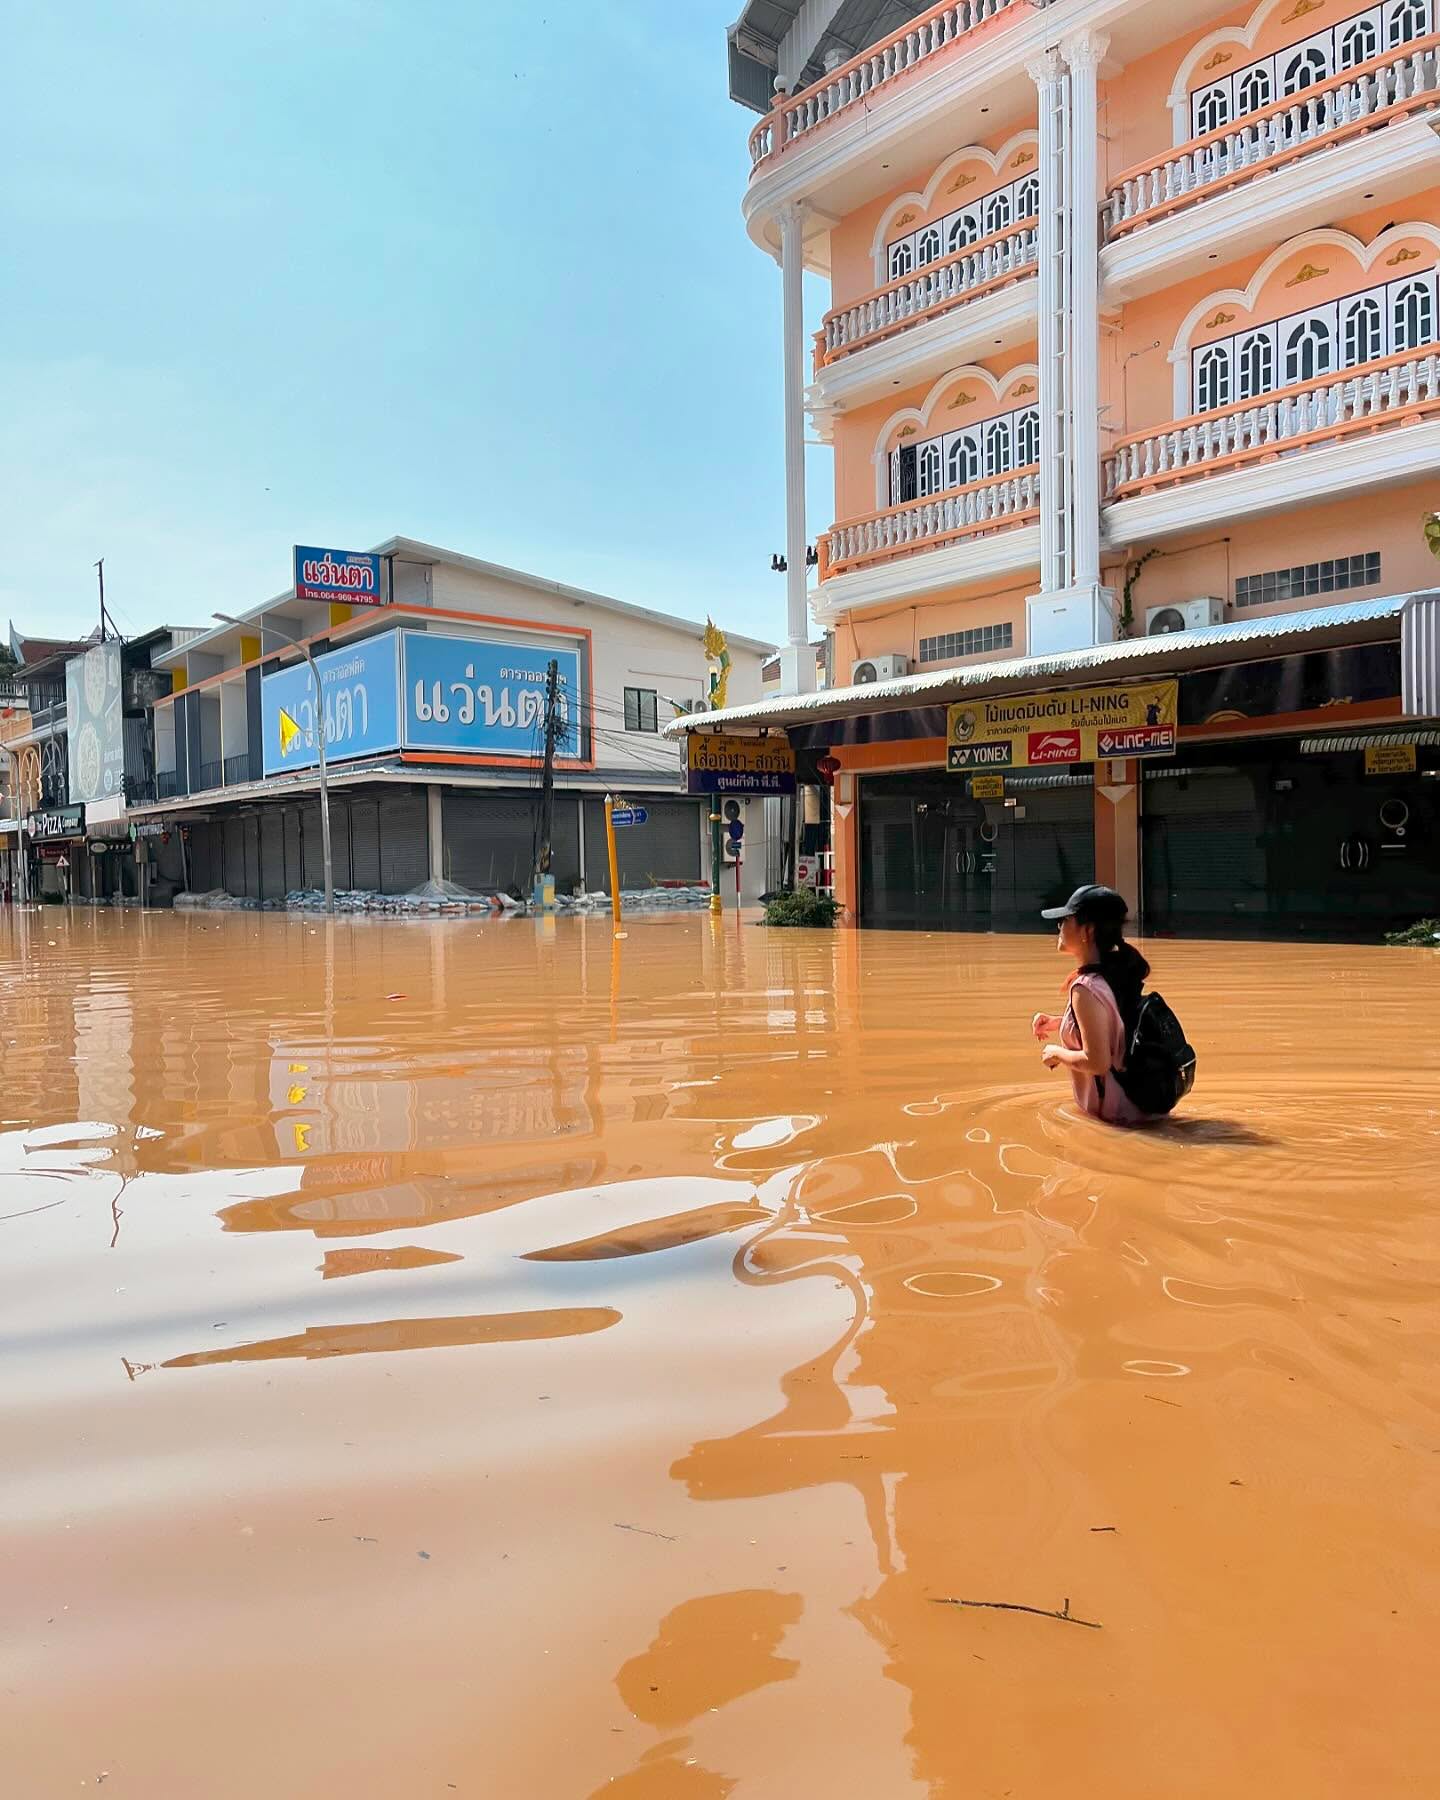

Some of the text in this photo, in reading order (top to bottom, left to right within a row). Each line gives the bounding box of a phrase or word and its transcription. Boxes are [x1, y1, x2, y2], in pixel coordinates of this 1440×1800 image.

[303, 553, 373, 590] แว่นตา
[984, 694, 1129, 723] ไม้แบดมินตัน LI-NING
[1115, 730, 1173, 749] LING-MEI
[973, 746, 1009, 763] YONEX
[1031, 748, 1078, 760] LI-NING
